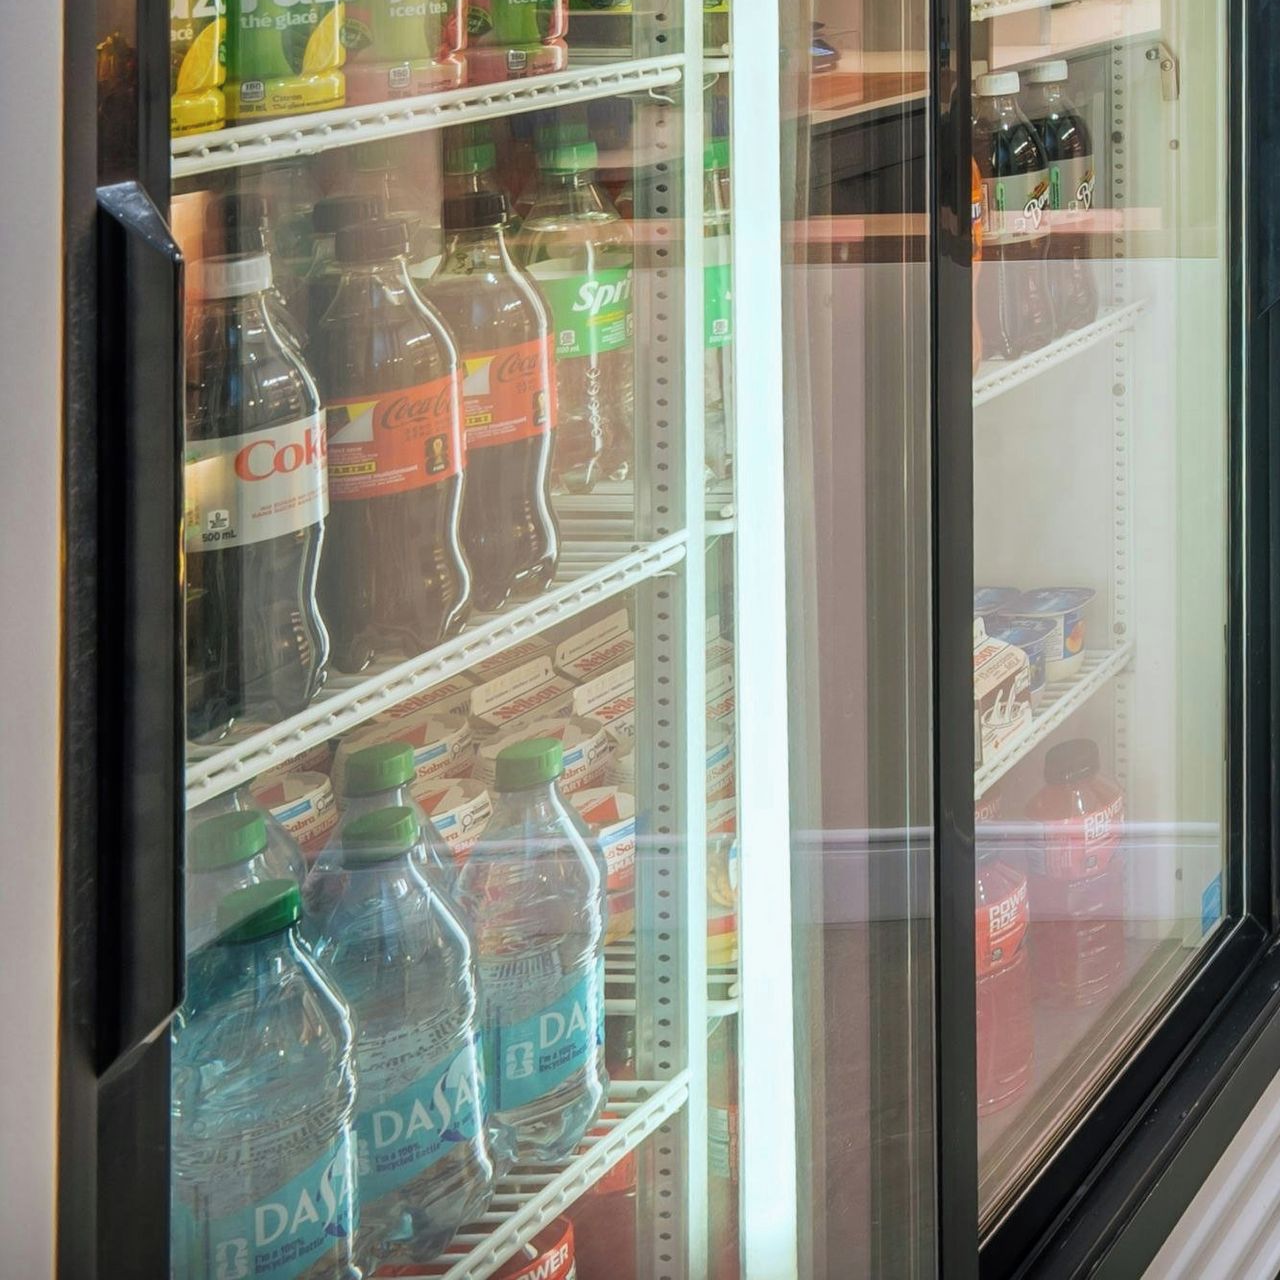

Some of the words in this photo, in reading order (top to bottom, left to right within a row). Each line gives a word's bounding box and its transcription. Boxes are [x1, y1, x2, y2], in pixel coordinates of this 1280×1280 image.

[389, 4, 427, 18] iced
[429, 2, 449, 15] tea
[240, 14, 273, 30] thé
[275, 11, 319, 32] glacé
[418, 757, 450, 778] Sabra
